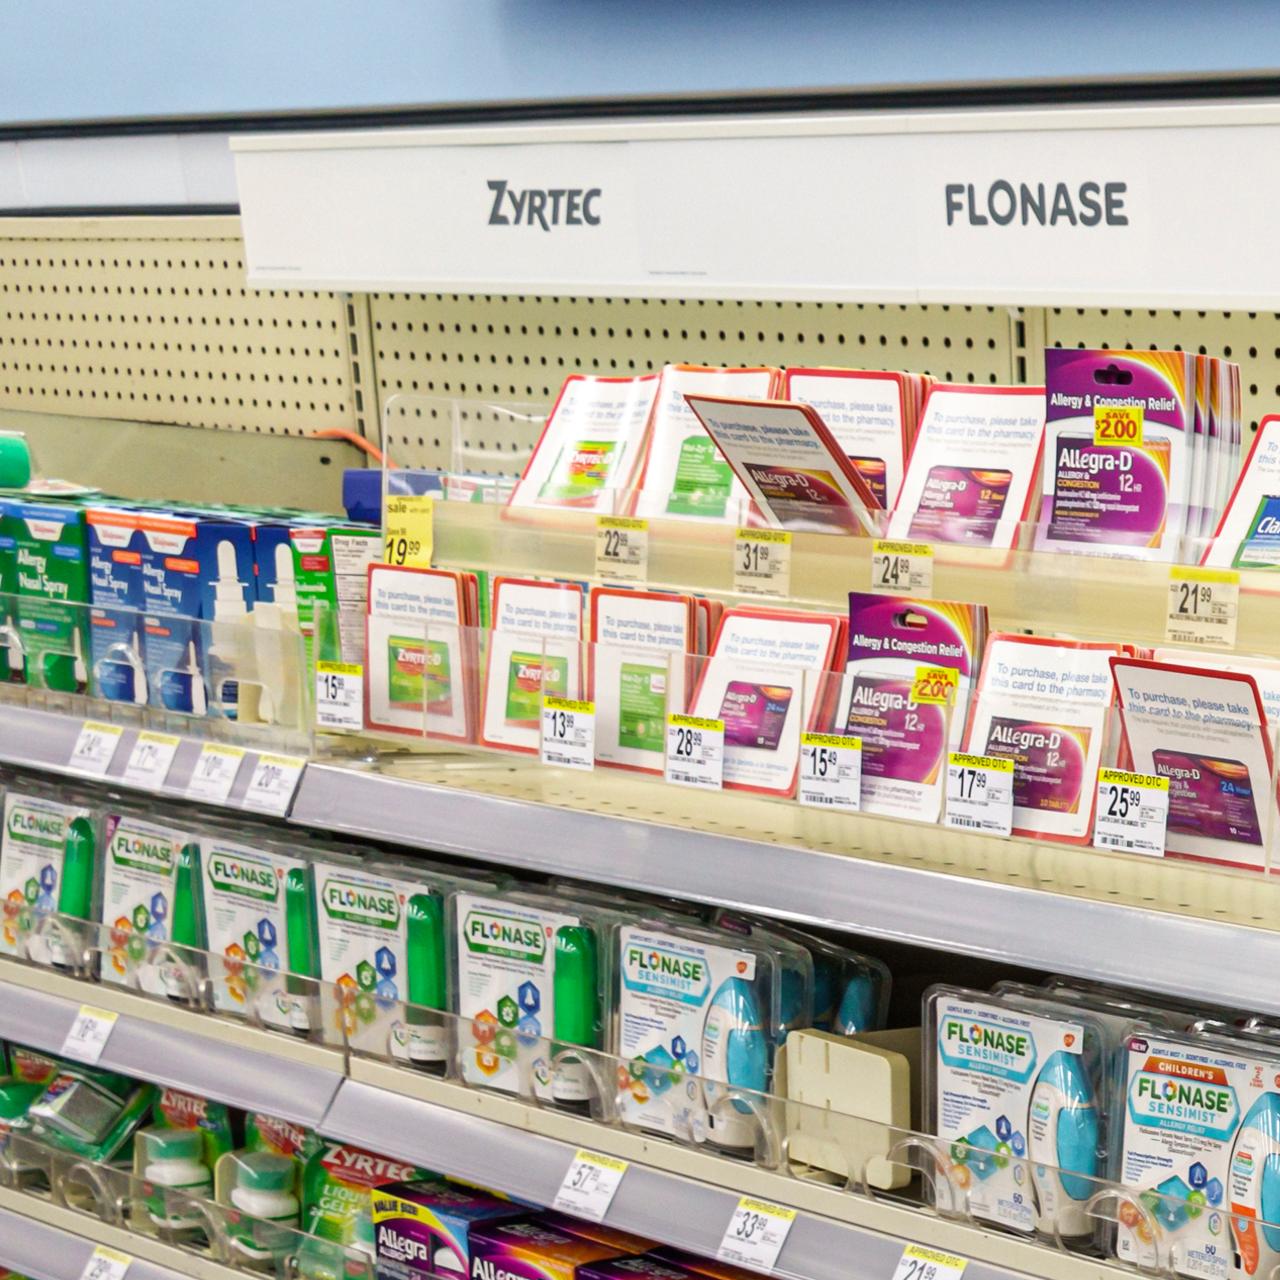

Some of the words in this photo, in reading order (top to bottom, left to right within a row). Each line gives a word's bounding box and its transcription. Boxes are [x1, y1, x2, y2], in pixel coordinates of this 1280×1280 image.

[487, 178, 602, 231] ZYRTEC
[944, 181, 1130, 228] FLONASE
[1051, 392, 1083, 410] Allergy
[1084, 395, 1092, 407] &
[1094, 395, 1145, 409] Congestion
[1147, 398, 1176, 412] Relief
[1104, 411, 1131, 420] SAVE
[1058, 449, 1133, 474] Allegra-D
[328, 889, 399, 916] FLONASE
[470, 923, 543, 951] FLONASE
[628, 951, 703, 981] FLONASE
[947, 1022, 1028, 1057] FLONASE
[957, 1044, 1017, 1066] SENSIMIST
[1158, 1063, 1214, 1078] CHILDREN'S
[1139, 1077, 1232, 1114] FLONASE
[1150, 1101, 1216, 1122] SENSIMIST
